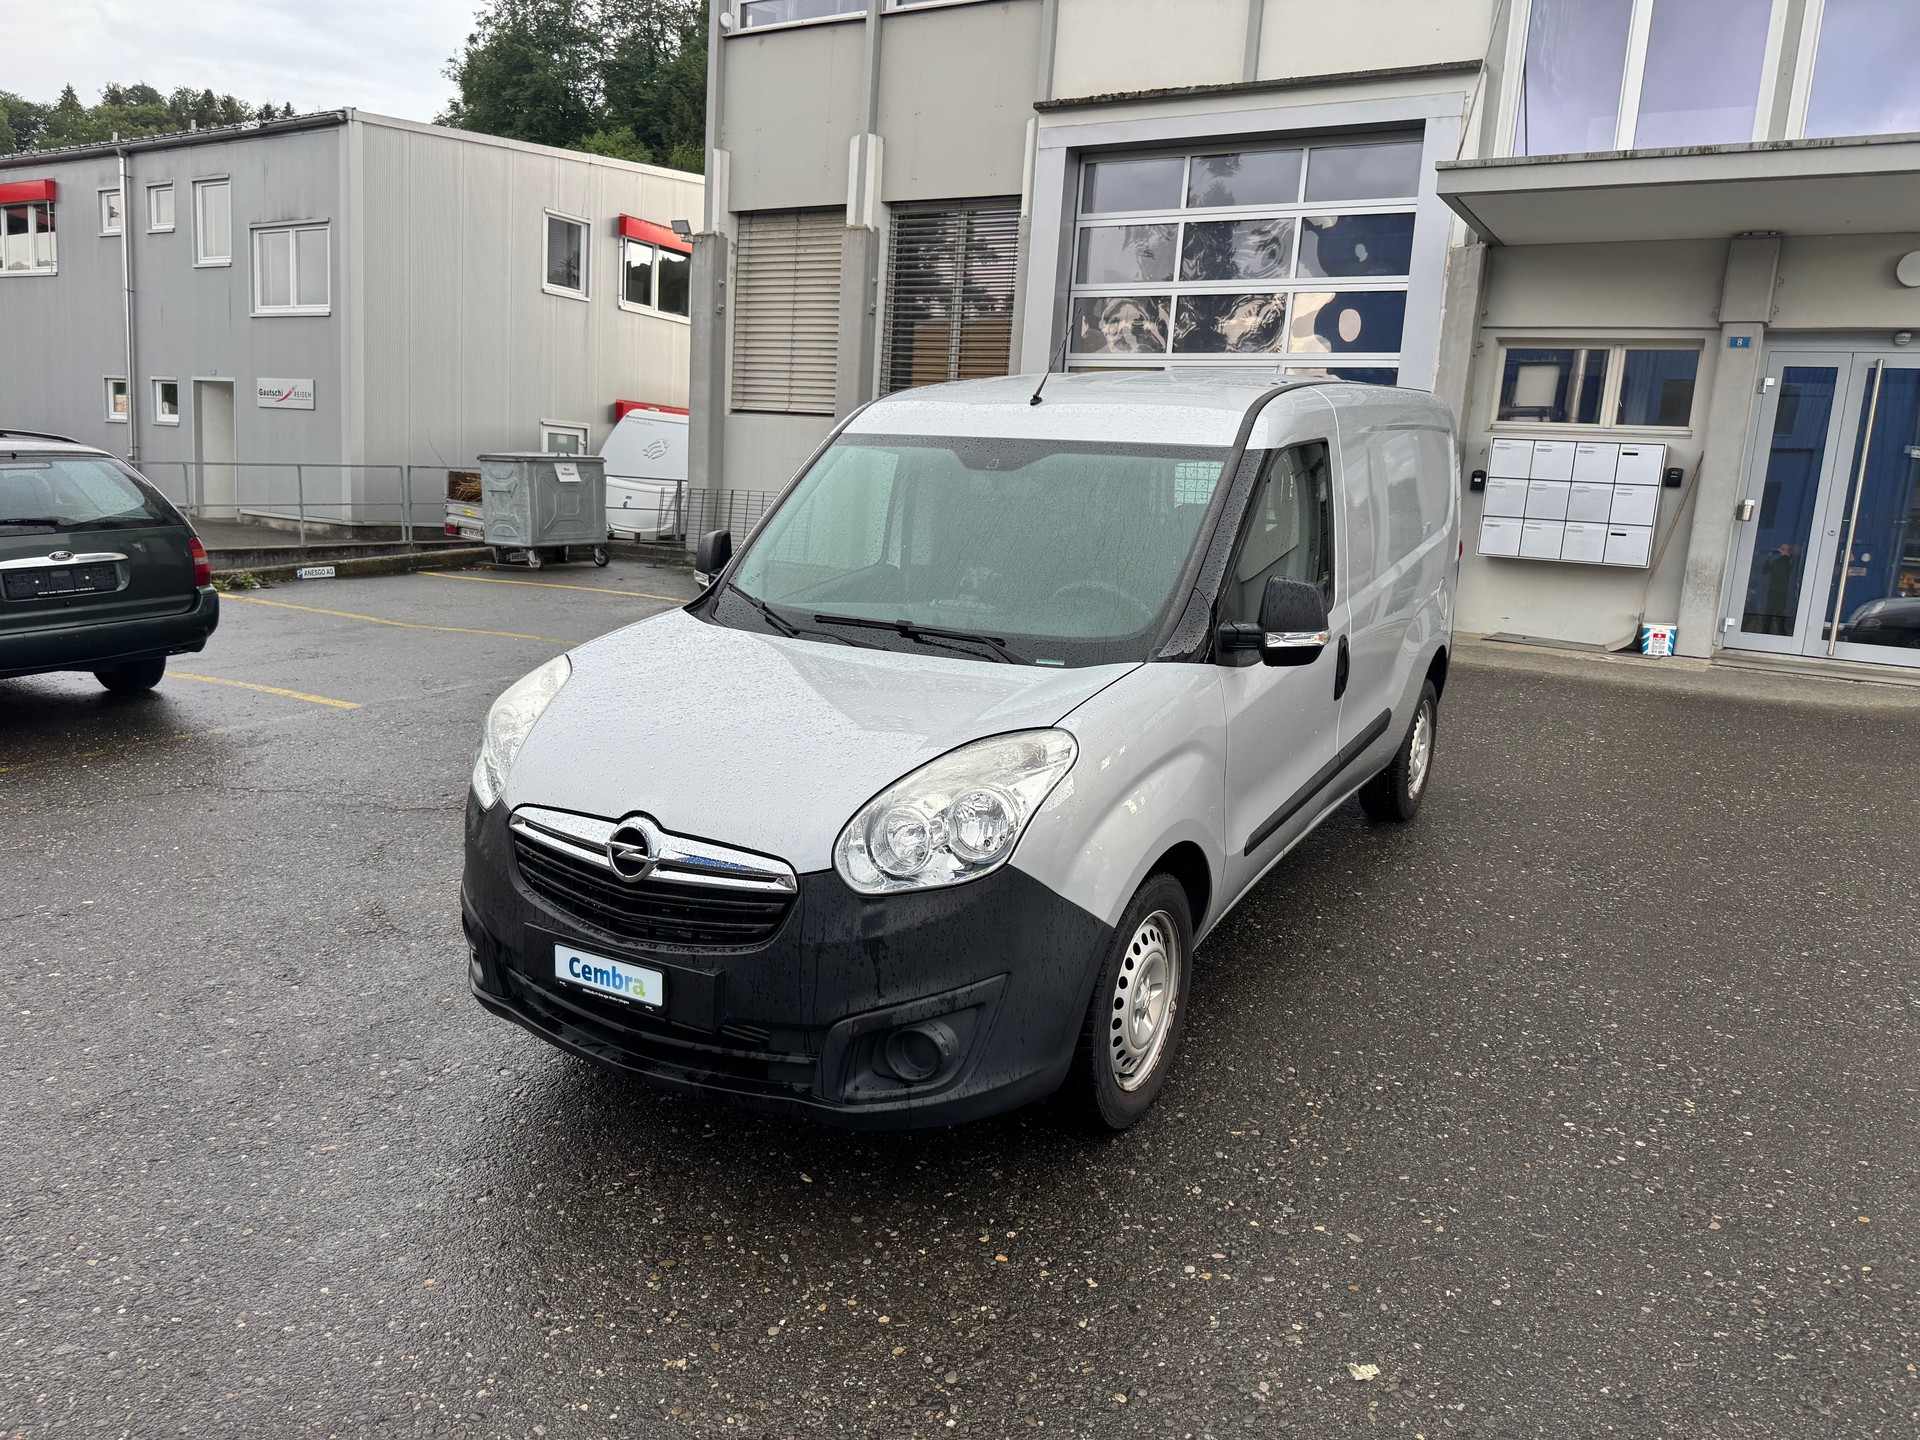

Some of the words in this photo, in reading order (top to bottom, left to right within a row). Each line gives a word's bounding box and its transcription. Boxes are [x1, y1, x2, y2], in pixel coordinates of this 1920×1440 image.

[1736, 337, 1743, 347] 8
[258, 388, 284, 397] Gautschi
[304, 569, 326, 577] ANESGO
[568, 956, 646, 998] Cembra
